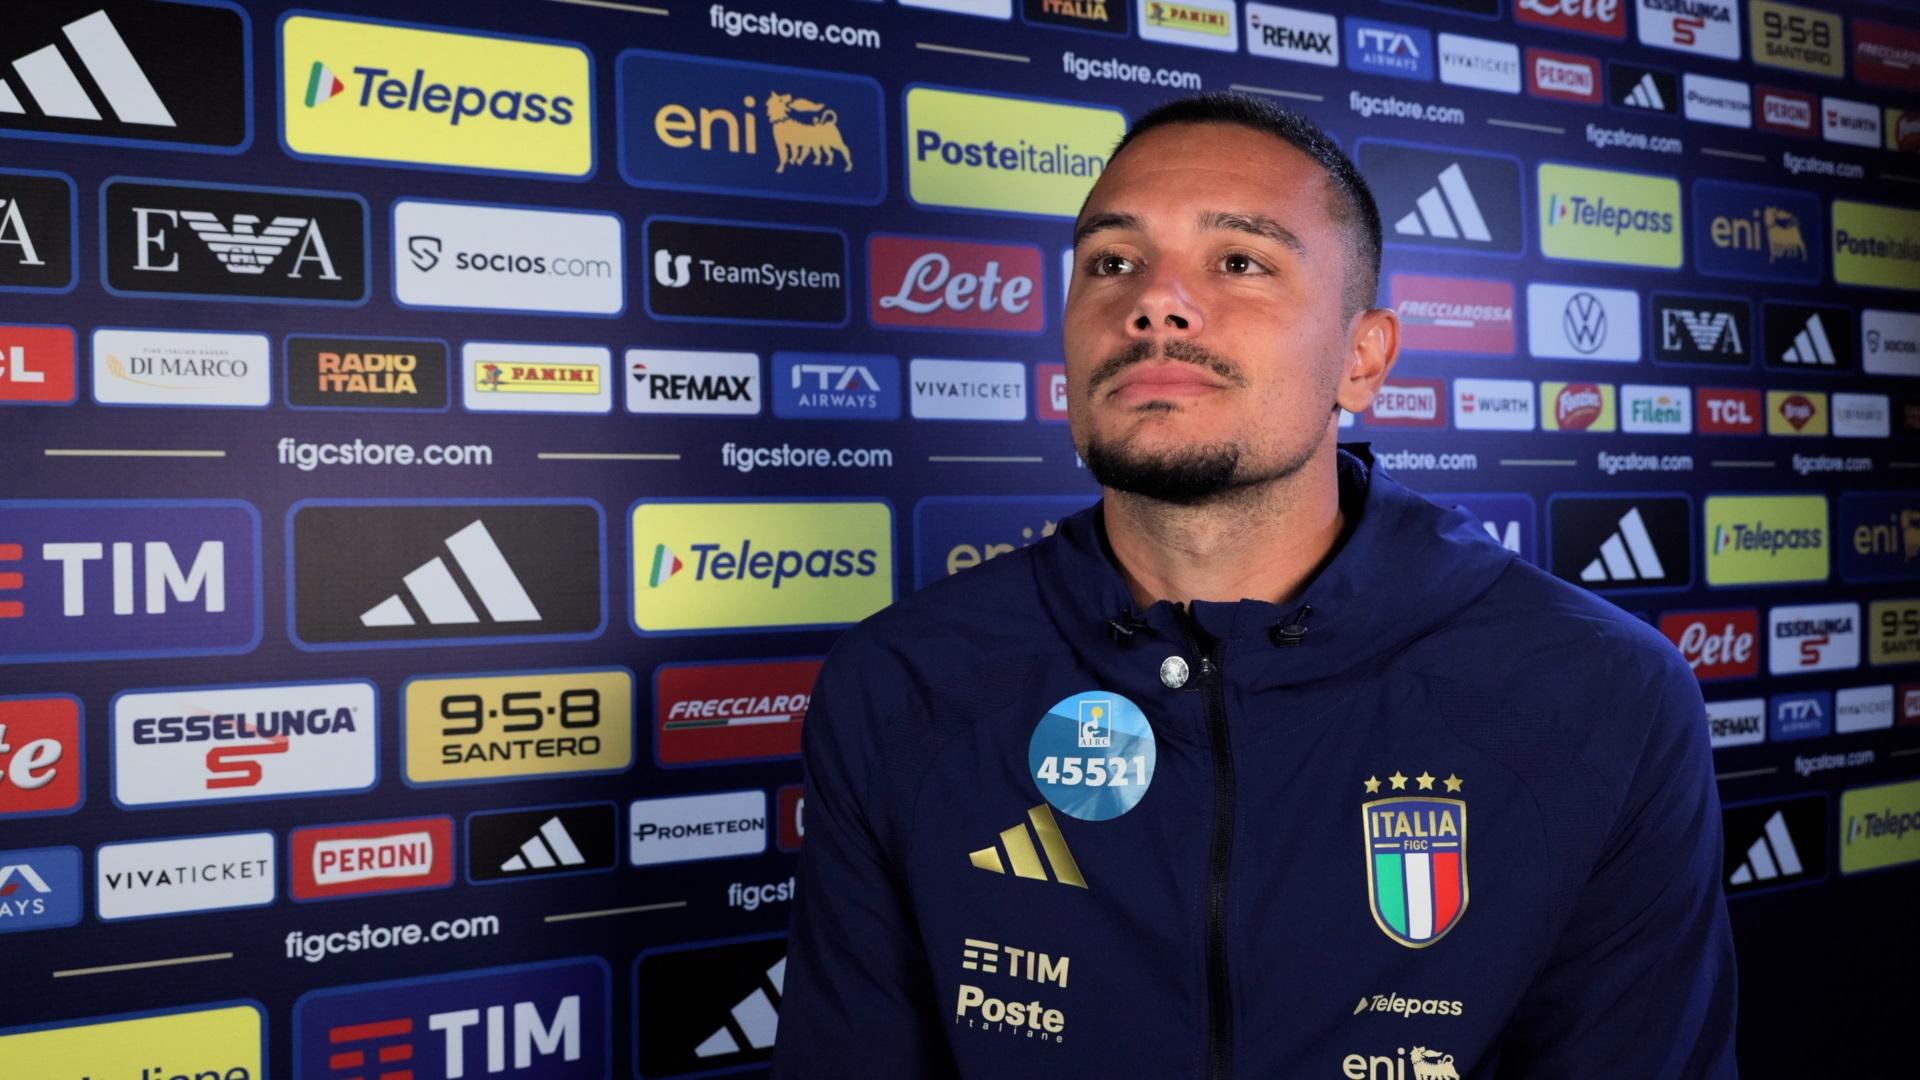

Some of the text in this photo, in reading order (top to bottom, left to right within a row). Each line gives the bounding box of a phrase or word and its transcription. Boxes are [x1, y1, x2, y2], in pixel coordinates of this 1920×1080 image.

[709, 4, 881, 49] figcstore.com
[1170, 8, 1226, 27] PANINI
[1357, 27, 1420, 58] ITA
[1765, 42, 1832, 67] SANTERO
[1062, 52, 1201, 90] figcstore.com
[1363, 52, 1419, 73] AIRWAYS
[1443, 53, 1517, 75] VIVATICKET
[1538, 65, 1591, 89] PERONI
[353, 66, 574, 126] Telepass
[1350, 89, 1465, 125] figcstore.com
[654, 96, 757, 154] eni
[1585, 123, 1683, 154] figcstore.com
[916, 129, 1106, 178] Posteitalian
[1570, 196, 1673, 236] Telepass
[1711, 208, 1762, 252] eni
[456, 252, 612, 278] SOCIOS.com
[700, 260, 841, 291] TeamSystem
[880, 252, 1034, 314] Lete
[1400, 301, 1513, 321] FRECCIAROSSA
[130, 357, 248, 378] DI MARCO
[318, 352, 417, 374] RADIO
[511, 367, 594, 382] PANINI
[318, 373, 418, 394] ITALIA
[650, 374, 752, 402] REMAX
[792, 364, 881, 392] ITA
[914, 381, 1022, 399] VIVATICKET
[798, 394, 877, 408] AIRWAYS
[1377, 394, 1433, 412] PERONI
[1631, 400, 1682, 424] Fileni
[1707, 399, 1753, 423] TCL
[277, 437, 493, 471] figcstore.com
[721, 442, 893, 472] figcstore.com
[1378, 450, 1477, 471] cstore.com
[1598, 451, 1693, 475] figcstore.com
[1733, 521, 1821, 557] Telepass
[1853, 513, 1898, 554] eni
[690, 539, 877, 588] Telepass
[42, 541, 225, 617] TIM
[1775, 616, 1853, 639] ESSELUNGA
[668, 694, 812, 720] FRECCIARO
[1777, 698, 1823, 722] ITA
[133, 707, 356, 745] ESSELUNGA
[442, 736, 600, 764] SANTERO
[1081, 738, 1108, 746] AIRC
[1037, 755, 1146, 787] 45521
[633, 817, 764, 842] PROMETEON
[1371, 810, 1457, 838] ITALIA
[1865, 809, 1920, 840] Telepa
[320, 842, 426, 874] PERONI
[1403, 839, 1428, 851] FIGC
[106, 859, 268, 890] VIVATICKET
[728, 876, 795, 911] figcst
[285, 915, 499, 962] figcstore.com
[1004, 945, 1070, 989] TIM
[957, 984, 1065, 1033] Poste
[1369, 992, 1463, 1018] Telepass
[428, 995, 580, 1079] TIM
[1342, 1047, 1405, 1080] eni
